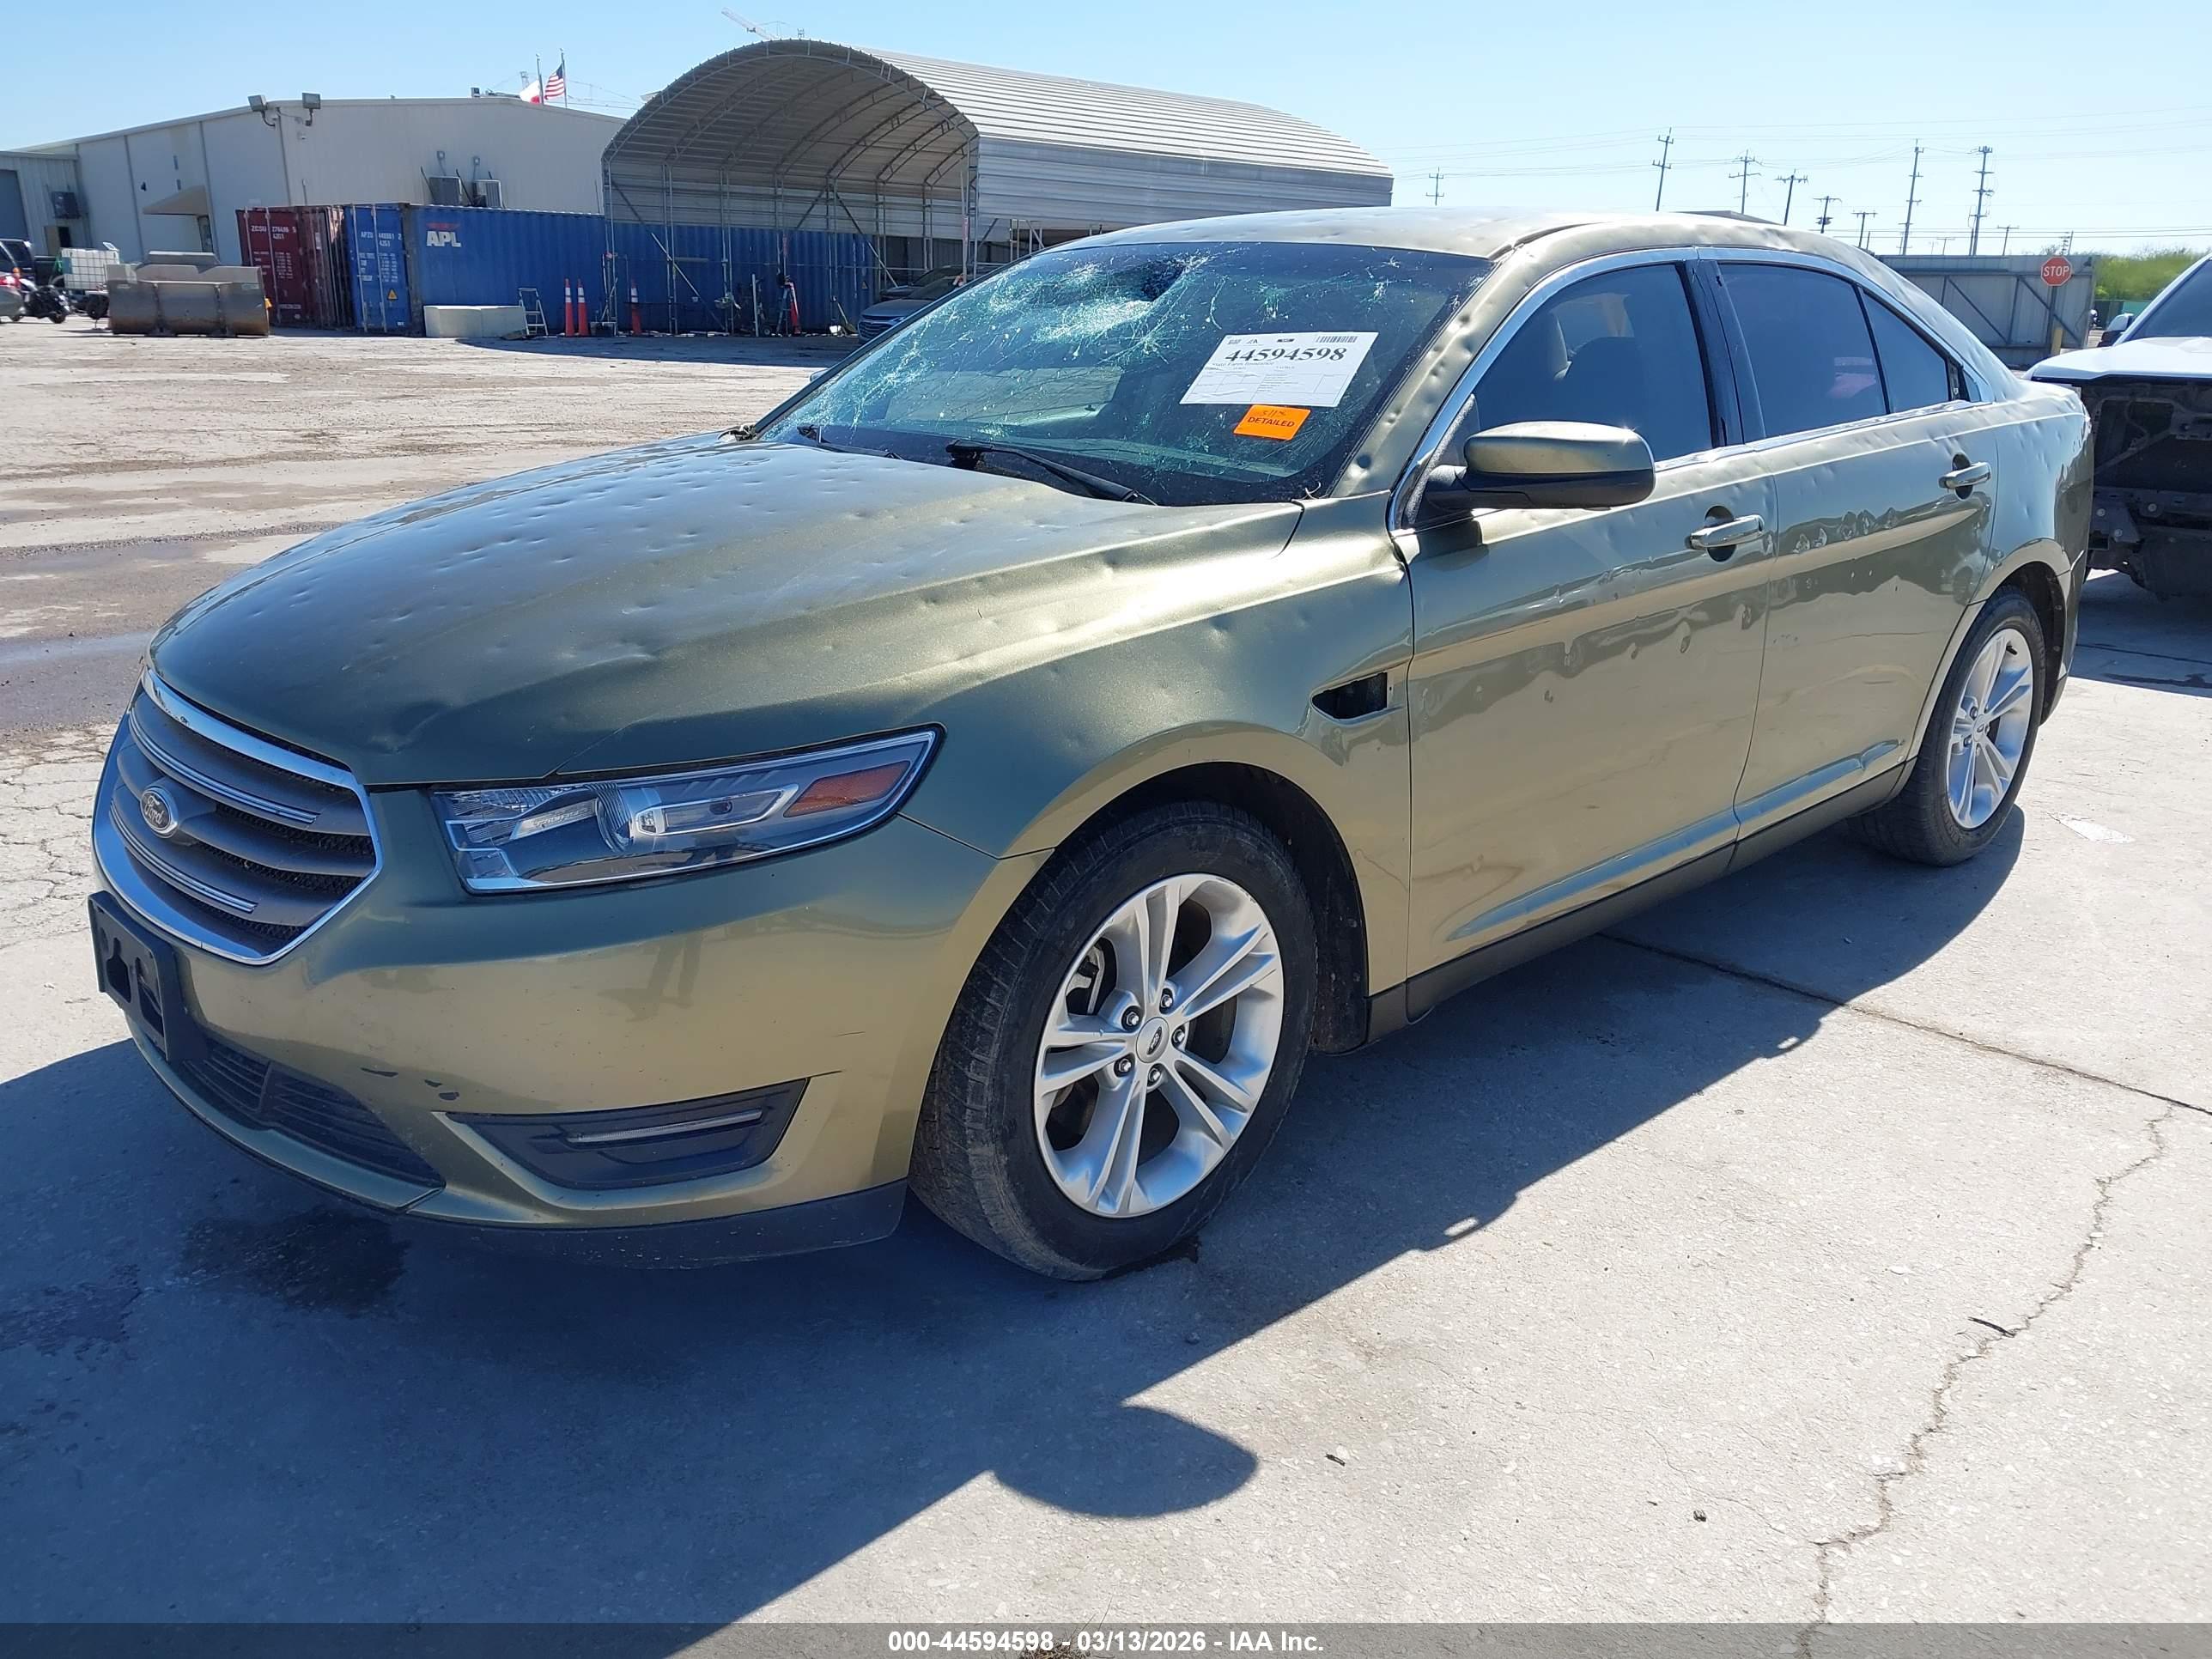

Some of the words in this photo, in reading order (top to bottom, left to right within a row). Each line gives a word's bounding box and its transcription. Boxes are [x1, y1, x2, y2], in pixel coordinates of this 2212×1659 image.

[427, 231, 461, 246] APL
[2044, 266, 2069, 276] STOP
[1225, 348, 1347, 362] 44594598
[1248, 417, 1295, 427] DETAILED
[144, 795, 165, 824] Ford
